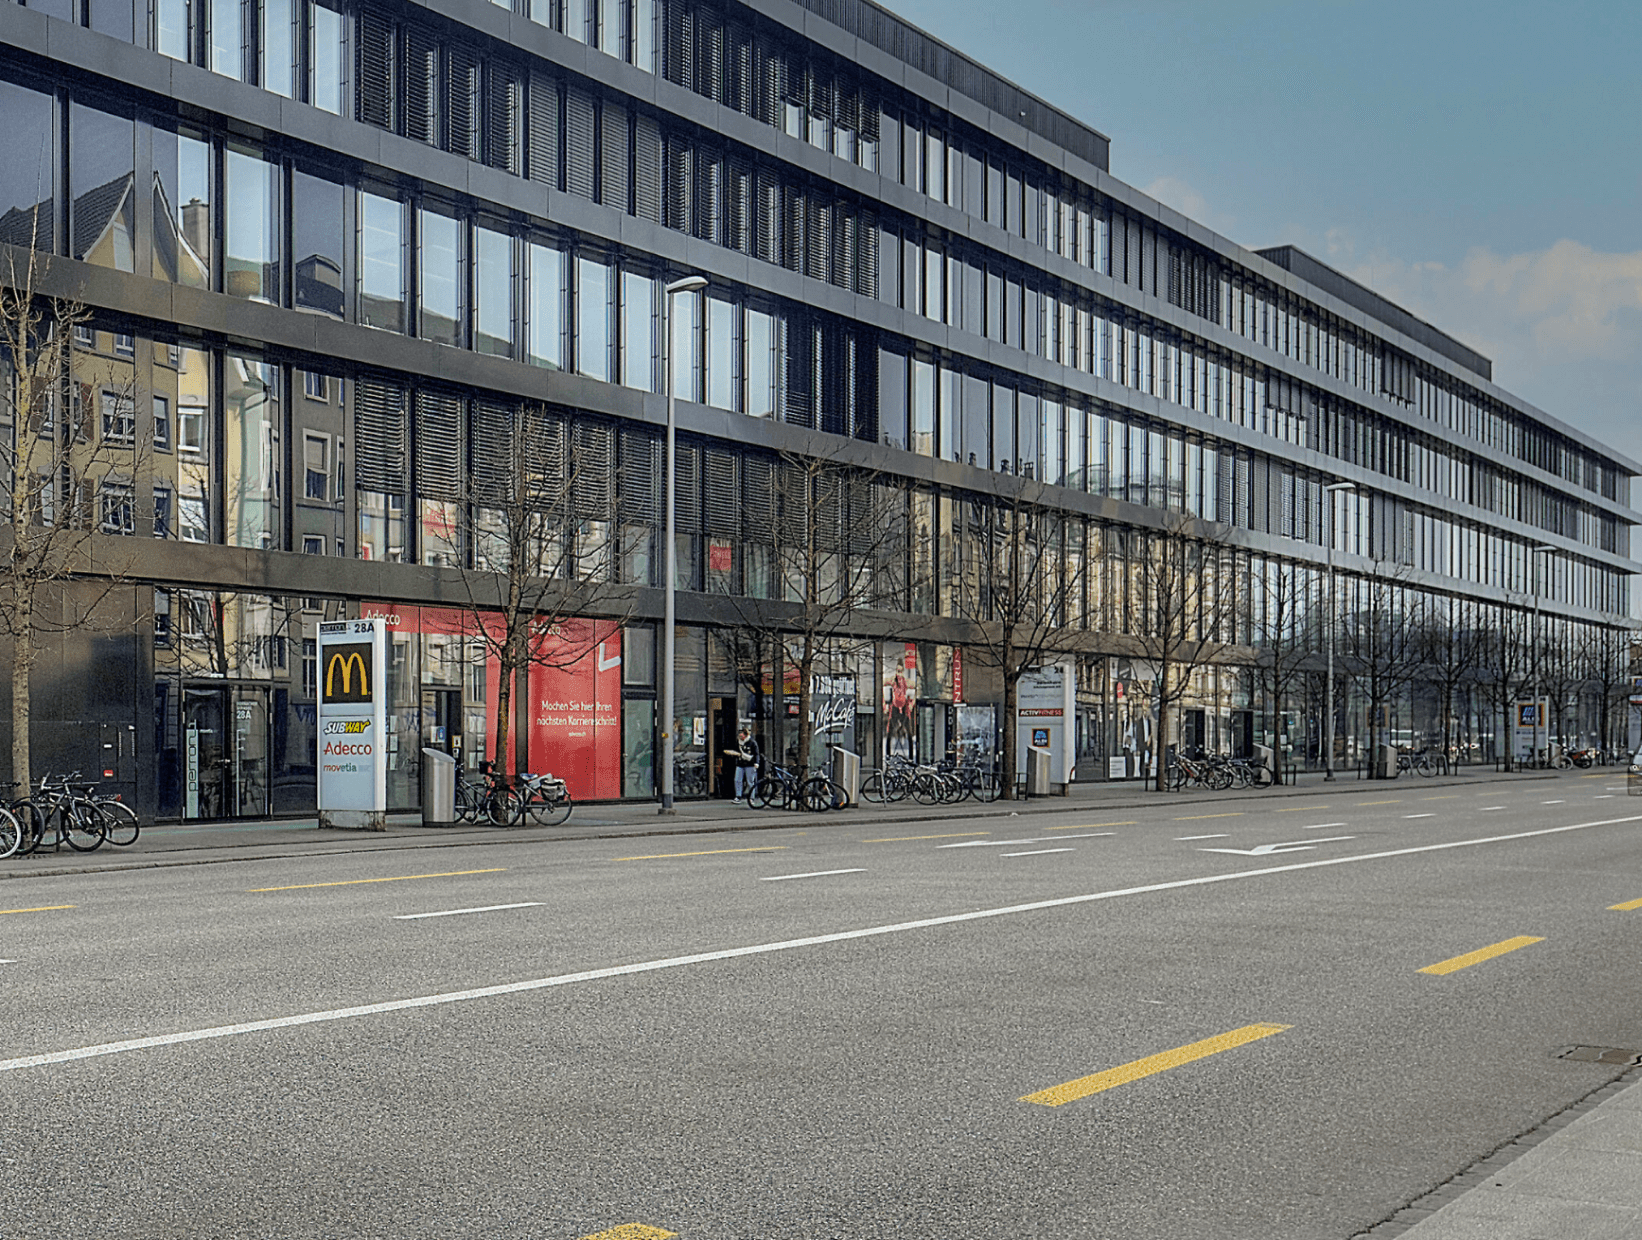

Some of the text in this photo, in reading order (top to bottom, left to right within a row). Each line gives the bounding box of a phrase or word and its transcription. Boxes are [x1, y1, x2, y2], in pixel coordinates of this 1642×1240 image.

[354, 622, 375, 634] 28A
[569, 700, 580, 711] Sie
[323, 719, 372, 736] SUBWAY
[323, 741, 373, 756] Adecco
[323, 762, 357, 773] movetia
